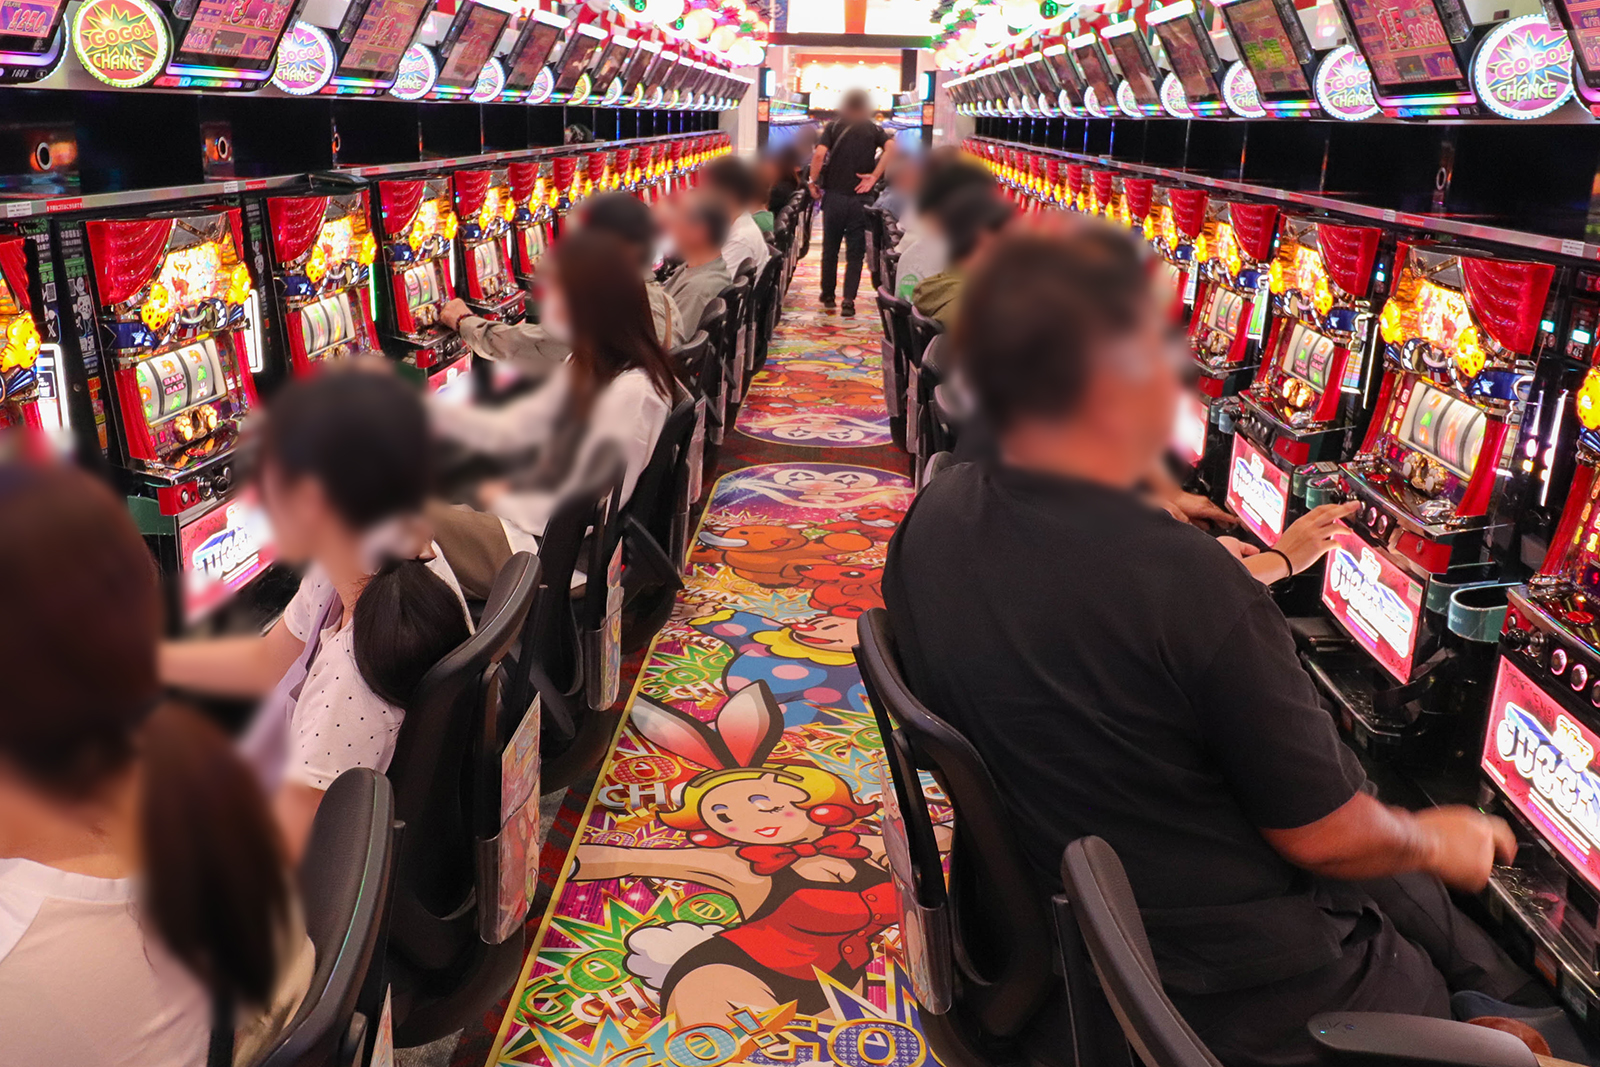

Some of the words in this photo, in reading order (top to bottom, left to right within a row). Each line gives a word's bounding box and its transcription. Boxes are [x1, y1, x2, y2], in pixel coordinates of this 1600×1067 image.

[90, 23, 149, 47] GOGO!
[93, 54, 144, 71] CHANCE
[1496, 44, 1568, 80] GOGO!
[276, 67, 315, 82] CHANCE
[1496, 82, 1557, 102] CHANCE
[163, 374, 183, 385] BAR
[165, 382, 185, 395] BAR
